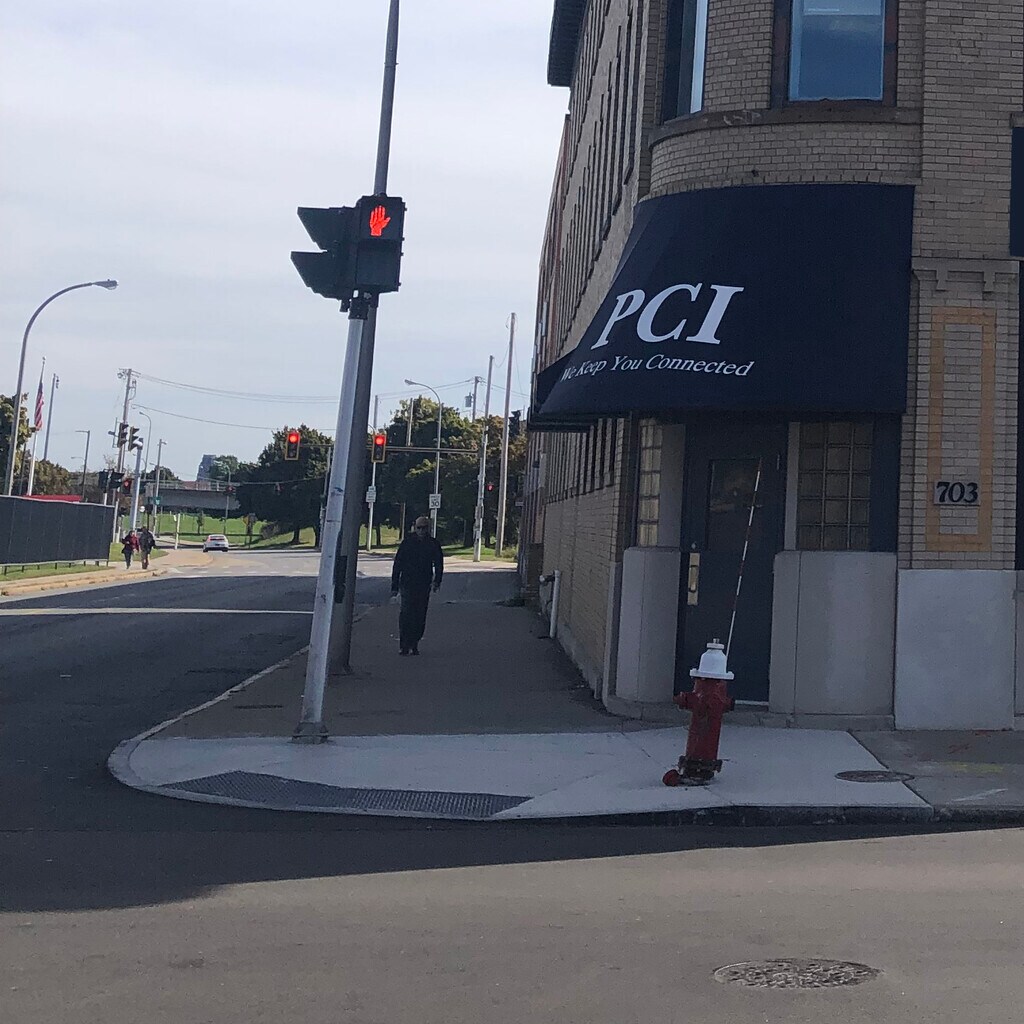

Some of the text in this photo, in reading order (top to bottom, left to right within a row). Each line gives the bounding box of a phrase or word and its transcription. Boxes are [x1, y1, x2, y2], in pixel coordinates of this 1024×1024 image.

[590, 282, 745, 350] PCI
[560, 353, 755, 382] We Keep You Connected
[936, 481, 979, 503] 703
